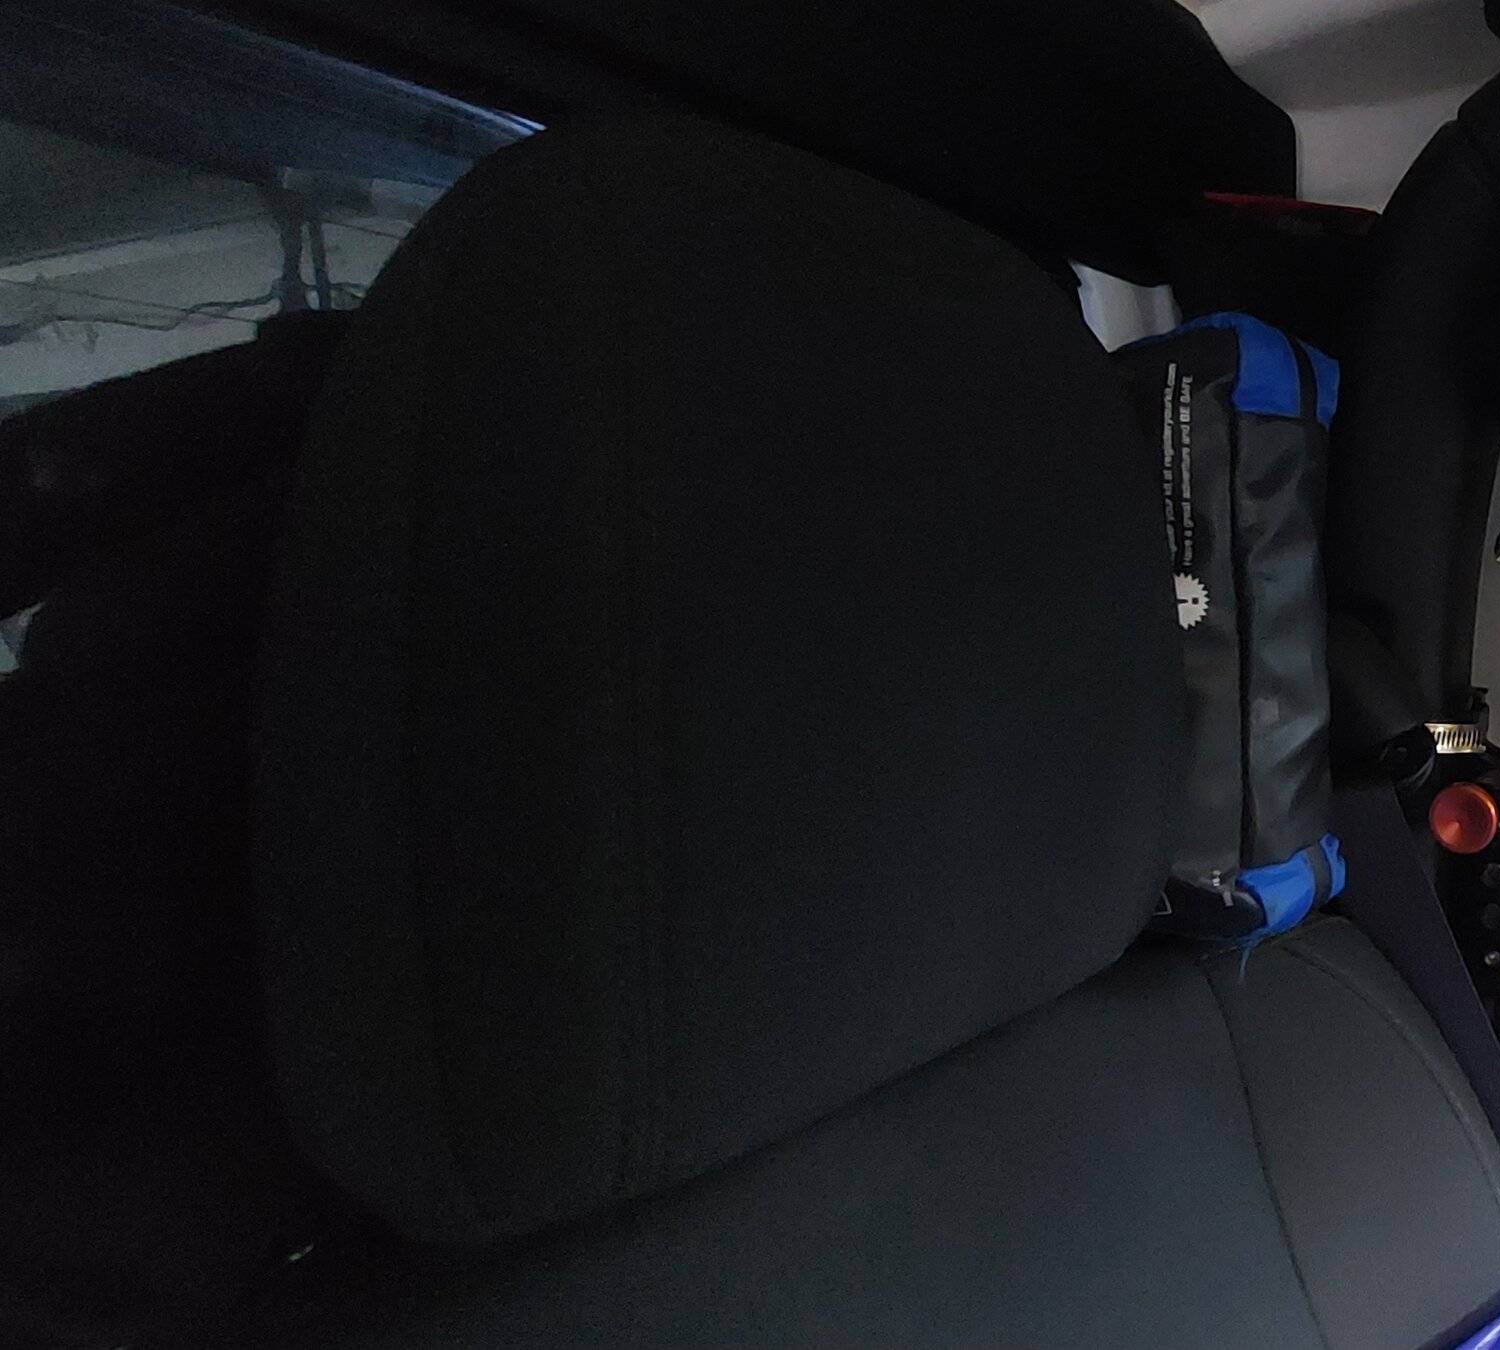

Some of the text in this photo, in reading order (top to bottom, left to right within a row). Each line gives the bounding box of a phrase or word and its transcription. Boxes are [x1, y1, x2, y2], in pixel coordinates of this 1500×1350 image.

[1180, 425, 1190, 444] and
[1181, 447, 1191, 498] adventure
[1181, 502, 1195, 527] great
